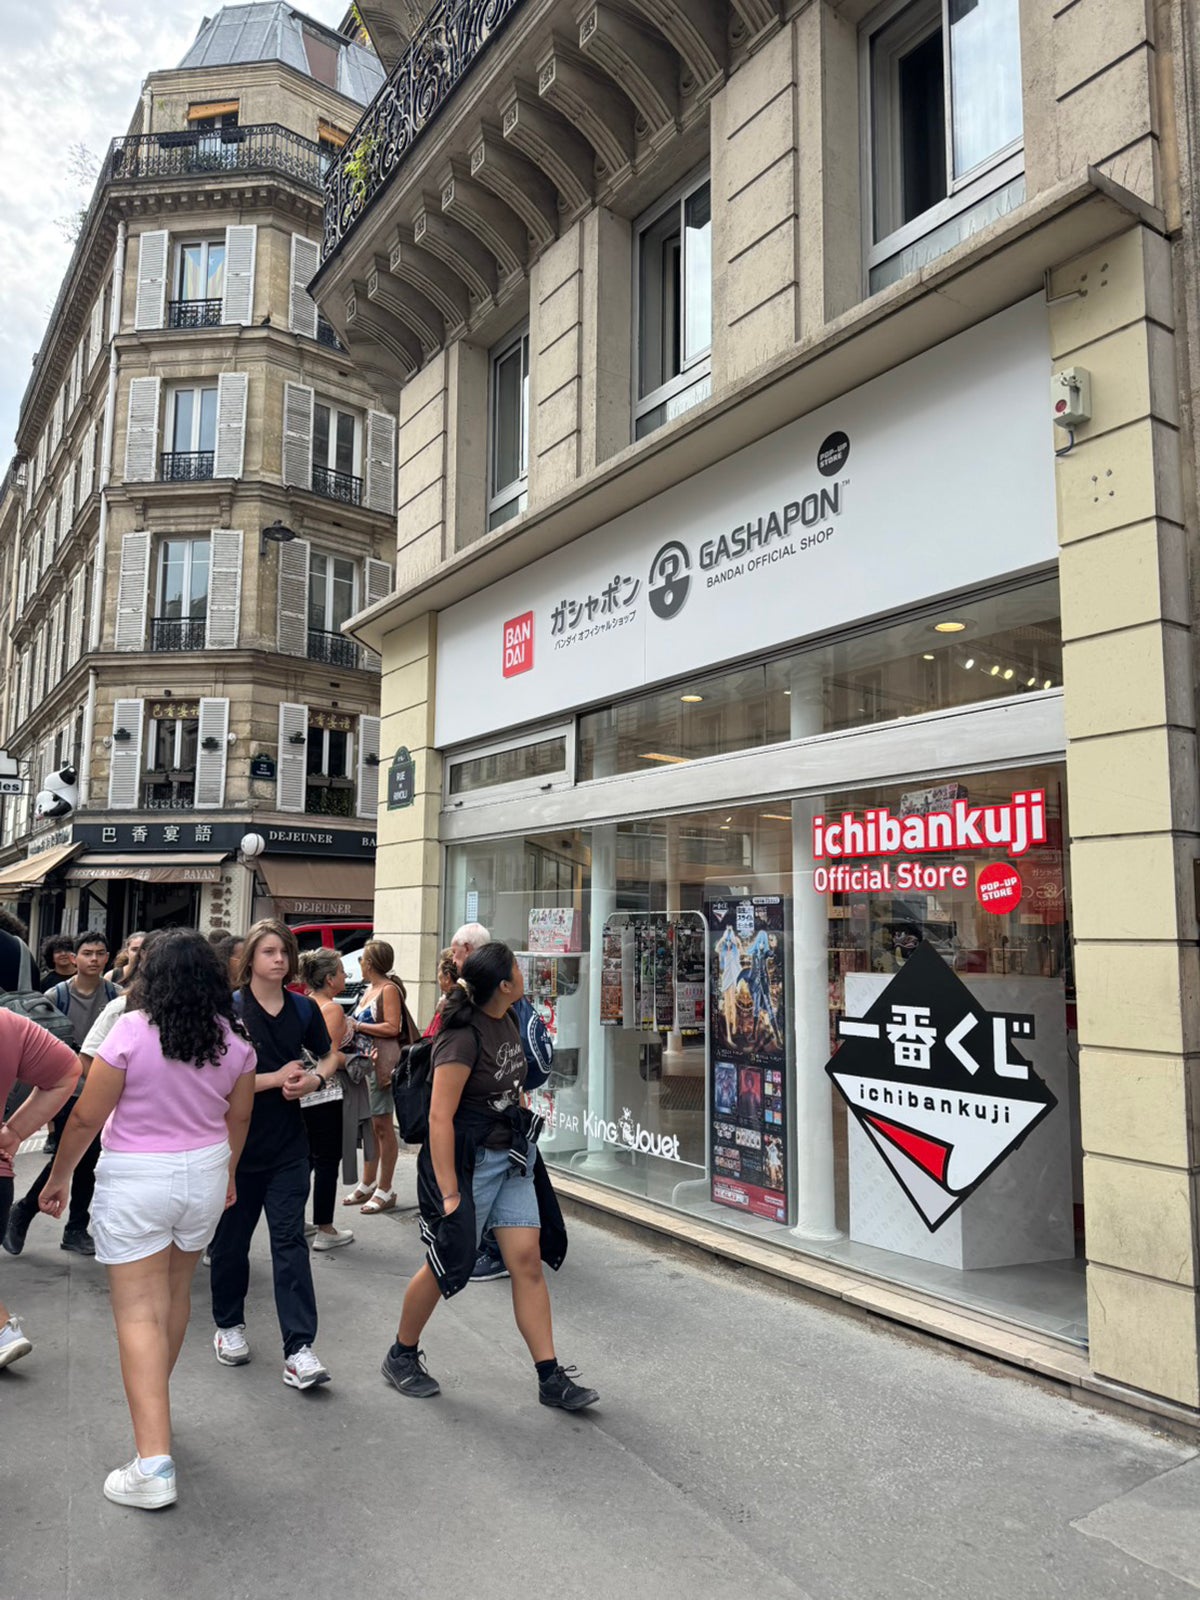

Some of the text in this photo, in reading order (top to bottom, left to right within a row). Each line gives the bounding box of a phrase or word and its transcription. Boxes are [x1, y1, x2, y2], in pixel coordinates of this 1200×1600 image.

[820, 442, 848, 460] POP-UP
[820, 452, 842, 468] STORE
[699, 482, 840, 571] GASHAPON
[706, 527, 834, 588] BANDAI OFFICIAL SHOP
[551, 574, 640, 636] ガシャポン
[505, 620, 531, 648] BAN
[505, 643, 525, 668] DAI
[396, 771, 406, 781] RUE
[102, 824, 212, 843] 巴香宴語
[813, 789, 1046, 858] ichibankuji
[269, 830, 333, 844] DEJEUNER
[183, 869, 215, 881] BAYAN
[814, 861, 968, 892] Official Store
[980, 876, 1019, 892] POP-UP
[982, 887, 1014, 902] STORE
[294, 901, 352, 914] DEJEUNER
[838, 1003, 1032, 1081] 一番くじ
[859, 1083, 1011, 1124] ichibankuji
[559, 1112, 580, 1134] PAR
